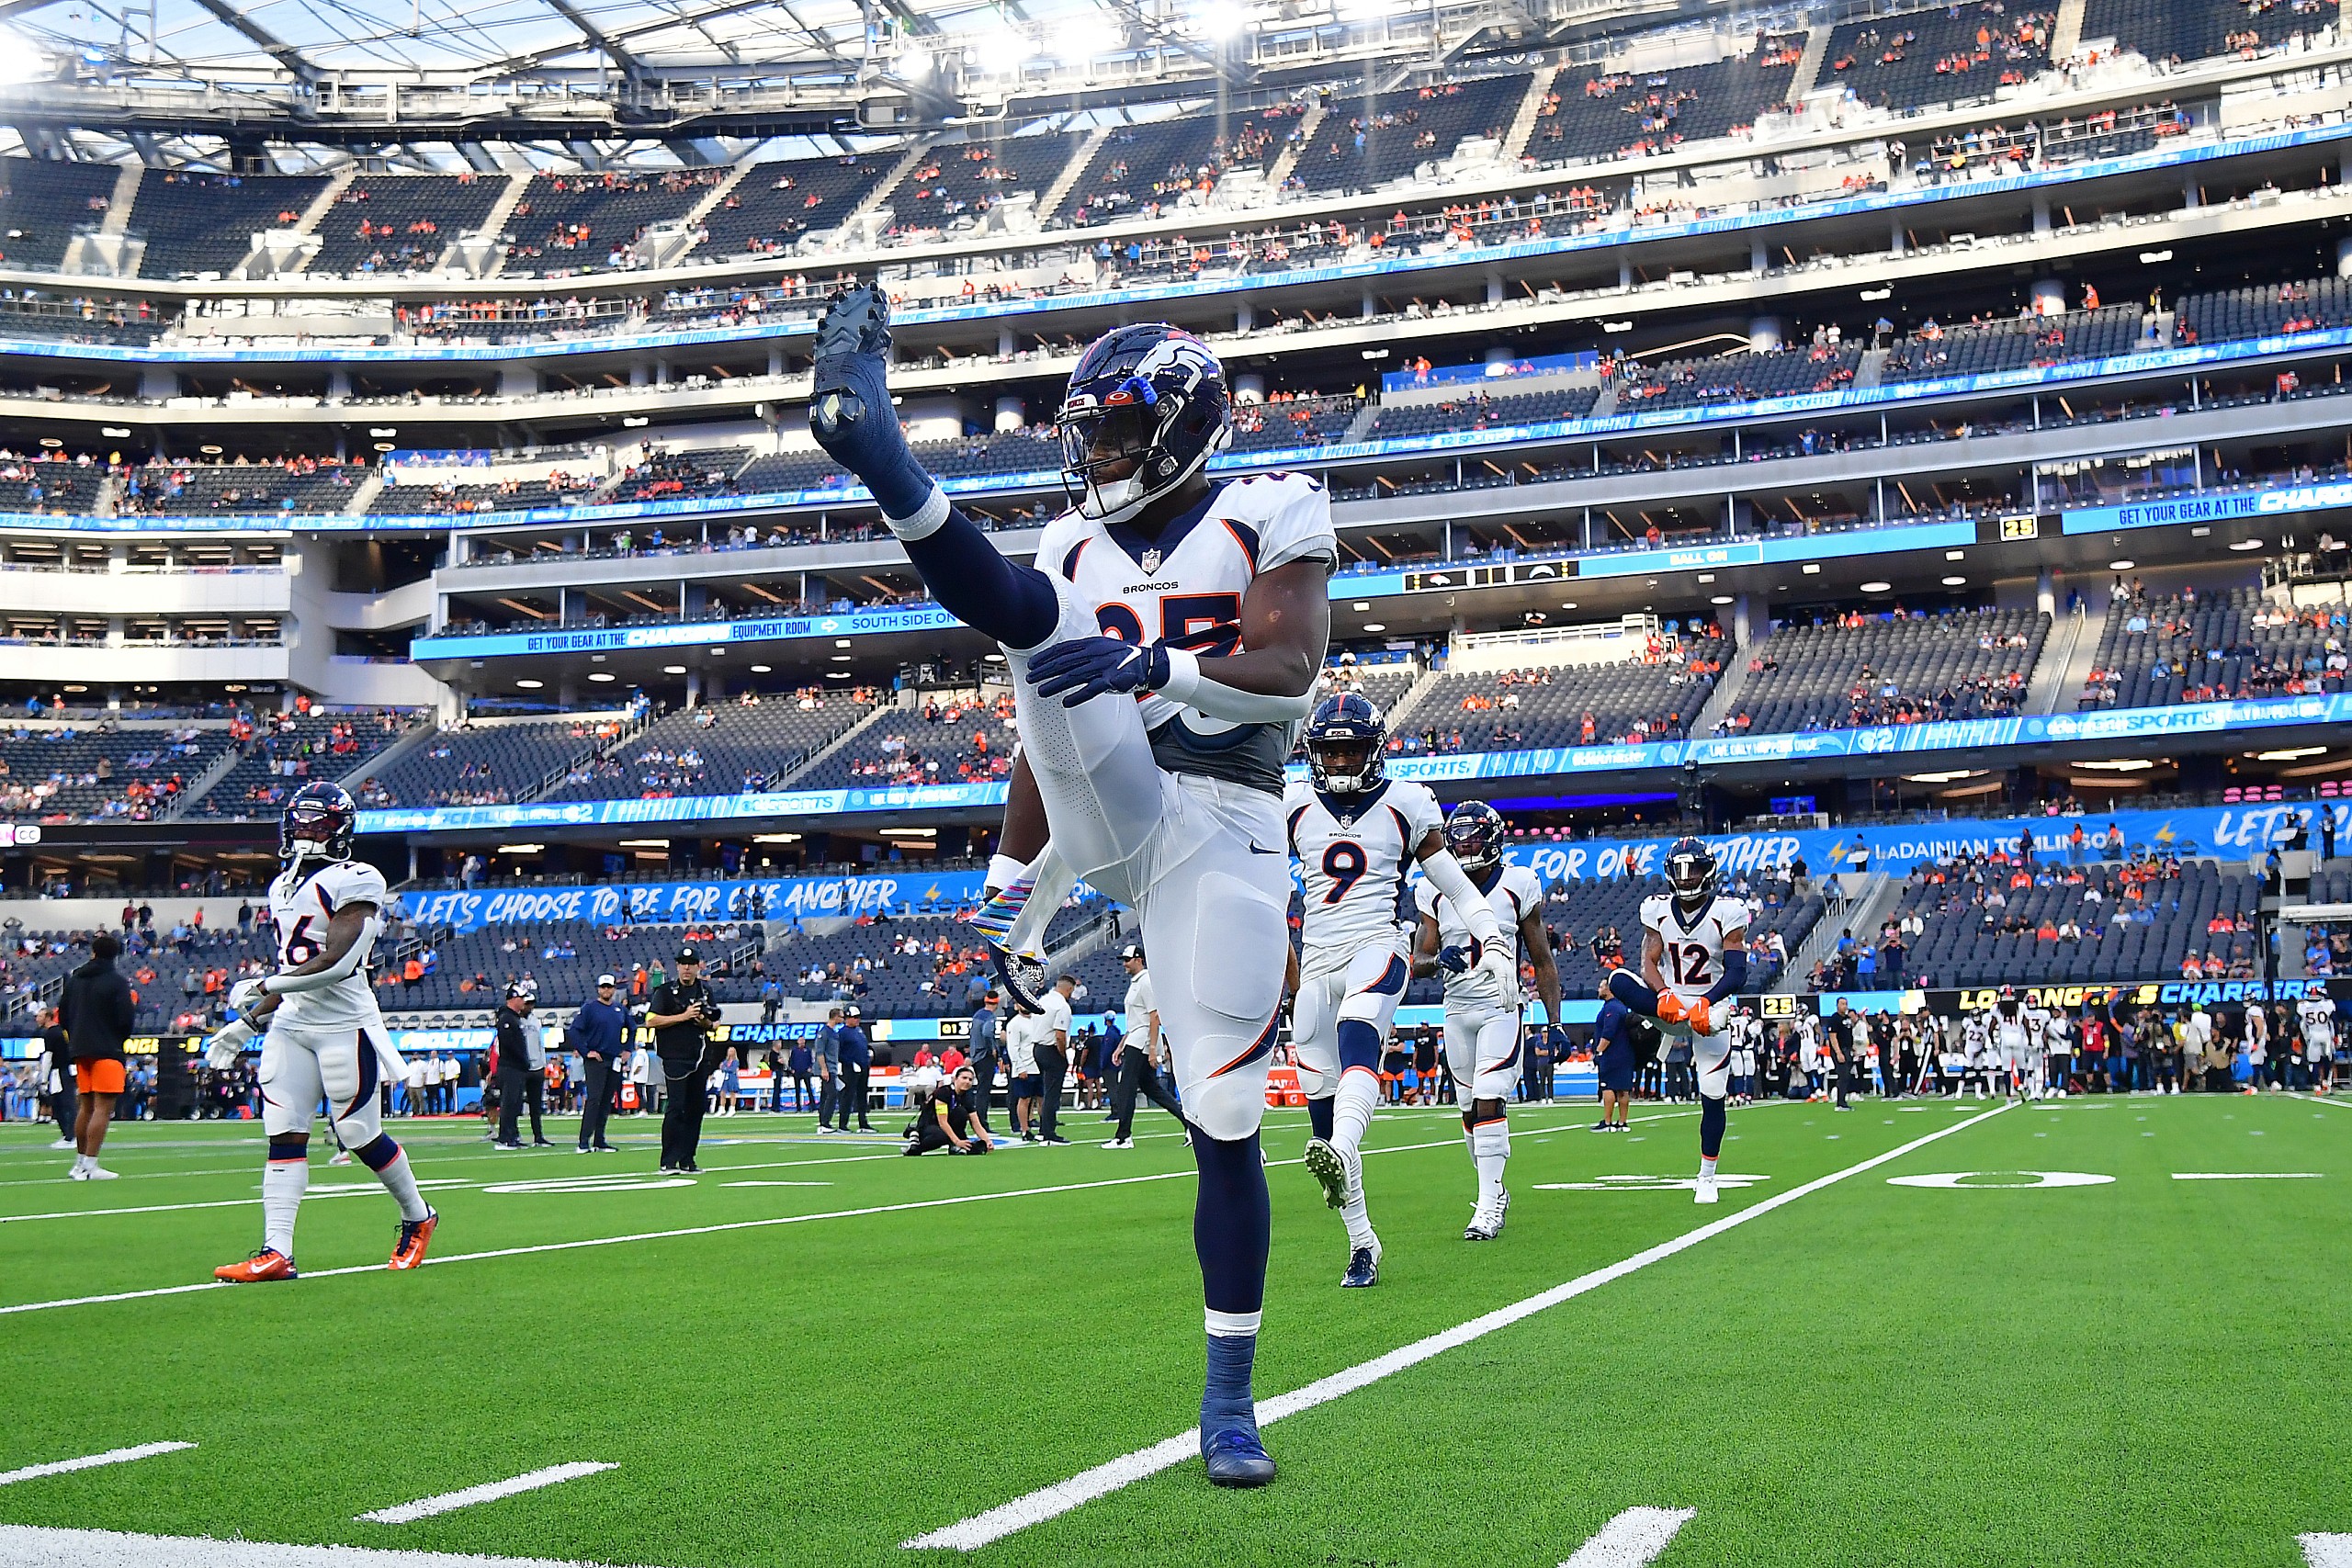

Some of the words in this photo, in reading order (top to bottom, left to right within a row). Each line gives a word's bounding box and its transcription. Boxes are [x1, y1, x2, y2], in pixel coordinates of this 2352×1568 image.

[2120, 509, 2140, 525] GET
[2143, 505, 2176, 522] YOUR
[2180, 502, 2211, 520] GEAR
[2214, 500, 2228, 515] AT
[2234, 497, 2256, 513] THE
[2004, 519, 2033, 537] 25
[1670, 553, 1705, 565] BALL
[1707, 550, 1729, 562] ON
[1123, 581, 1179, 594] BRONCOS
[852, 615, 899, 629] SOUTH
[901, 613, 932, 626] SIDE
[528, 637, 544, 650] GET
[547, 636, 569, 649] YOUR
[571, 634, 594, 648] GEAR
[596, 633, 606, 646] AT
[610, 632, 625, 646] THE
[732, 621, 783, 640] EQUIPMENT
[786, 621, 811, 635] ROOM
[1393, 761, 1470, 779] SPORTS
[19, 830, 37, 840] CC
[1531, 847, 1588, 886] FOR
[1714, 835, 1801, 874] OTHER
[1321, 840, 1369, 905] 9
[414, 891, 482, 927] LET'S
[485, 889, 586, 926] CHOOSE
[591, 886, 620, 919] TO
[630, 887, 663, 915] BE
[670, 886, 729, 917] FOR
[1668, 942, 1712, 985] 12
[1765, 998, 1792, 1014] 25
[1959, 989, 2000, 1010] LO
[2306, 1011, 2327, 1025] 50
[730, 1022, 844, 1044] CHARGE
[621, 1088, 635, 1102] G
